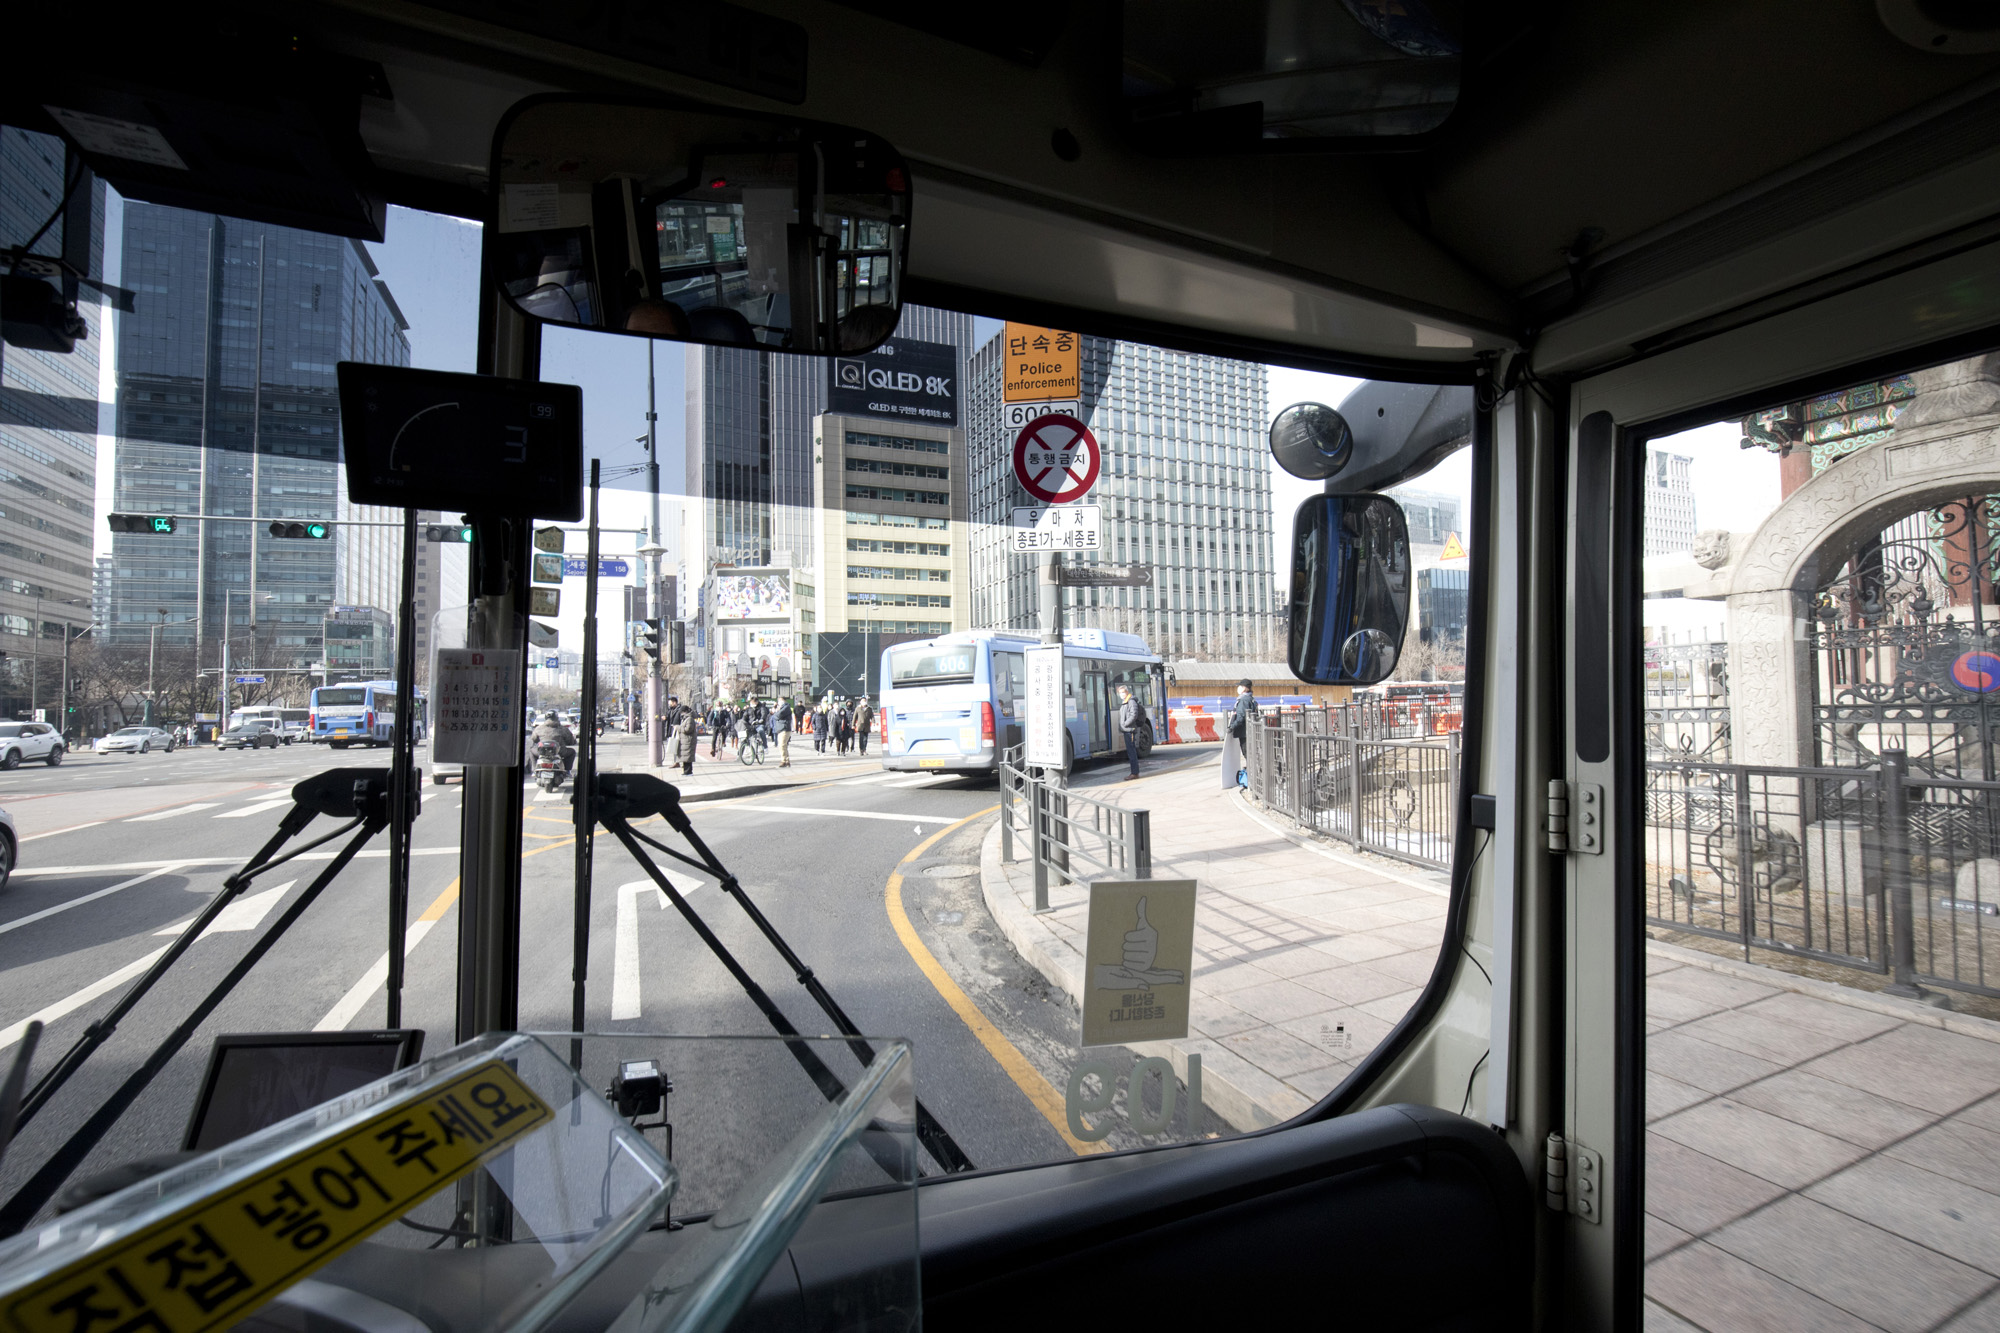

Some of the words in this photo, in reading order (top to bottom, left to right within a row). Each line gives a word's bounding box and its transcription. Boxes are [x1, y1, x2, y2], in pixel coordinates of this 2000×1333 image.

[1010, 332, 1074, 357] 단속중
[841, 364, 861, 385] Q
[1020, 362, 1062, 376] Police
[867, 368, 923, 393] QLED
[926, 376, 951, 397] 8K
[1007, 376, 1076, 391] enforcement
[536, 406, 552, 417] 99
[868, 402, 890, 412] QLED
[504, 424, 528, 464] 3
[1028, 453, 1085, 465] 통행금지
[1029, 509, 1084, 529] 우마차
[615, 565, 626, 573] 158
[939, 656, 966, 673] 606
[49, 1222, 255, 1333] 직접
[243, 1148, 392, 1253] 넣어
